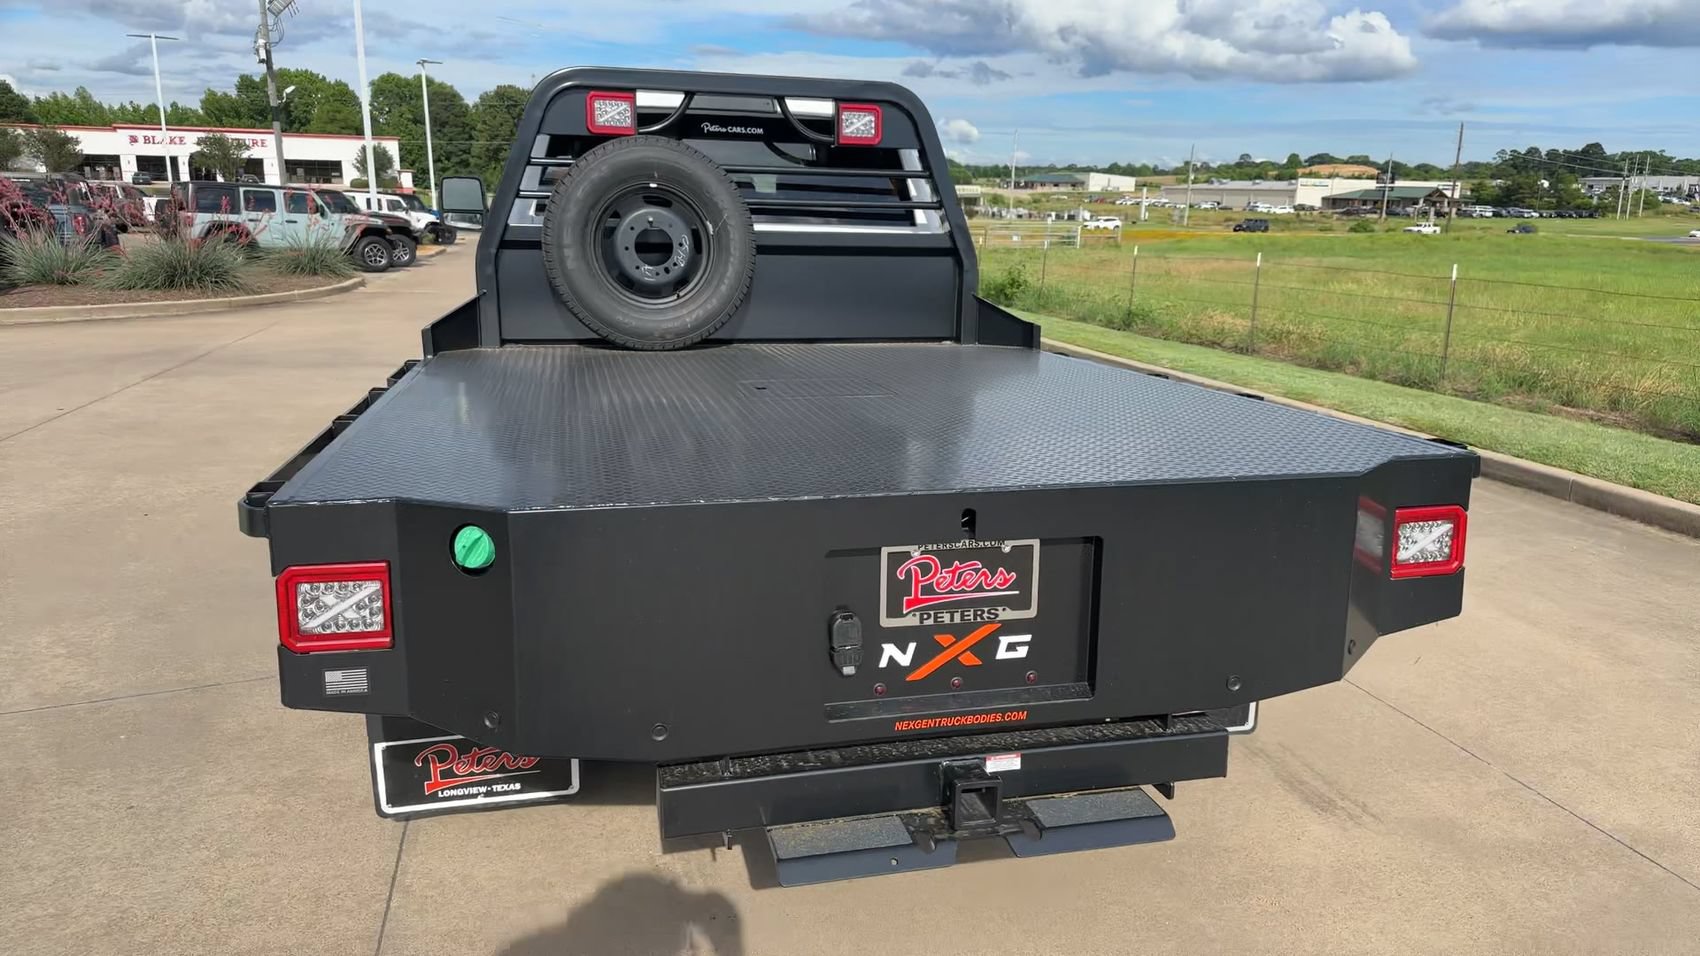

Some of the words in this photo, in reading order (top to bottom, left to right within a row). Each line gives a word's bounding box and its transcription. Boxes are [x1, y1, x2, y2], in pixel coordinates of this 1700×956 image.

[727, 126, 764, 134] CARS.COM
[917, 540, 1005, 551] PETERSCARS.COM
[897, 554, 1019, 613] Peters
[919, 608, 999, 625] PETERS
[894, 710, 1028, 731] NEXGENTRUCKBODIES.COM
[414, 743, 542, 796] Peters
[438, 785, 487, 798] LONGVIEW
[491, 782, 521, 793] TEXAS
